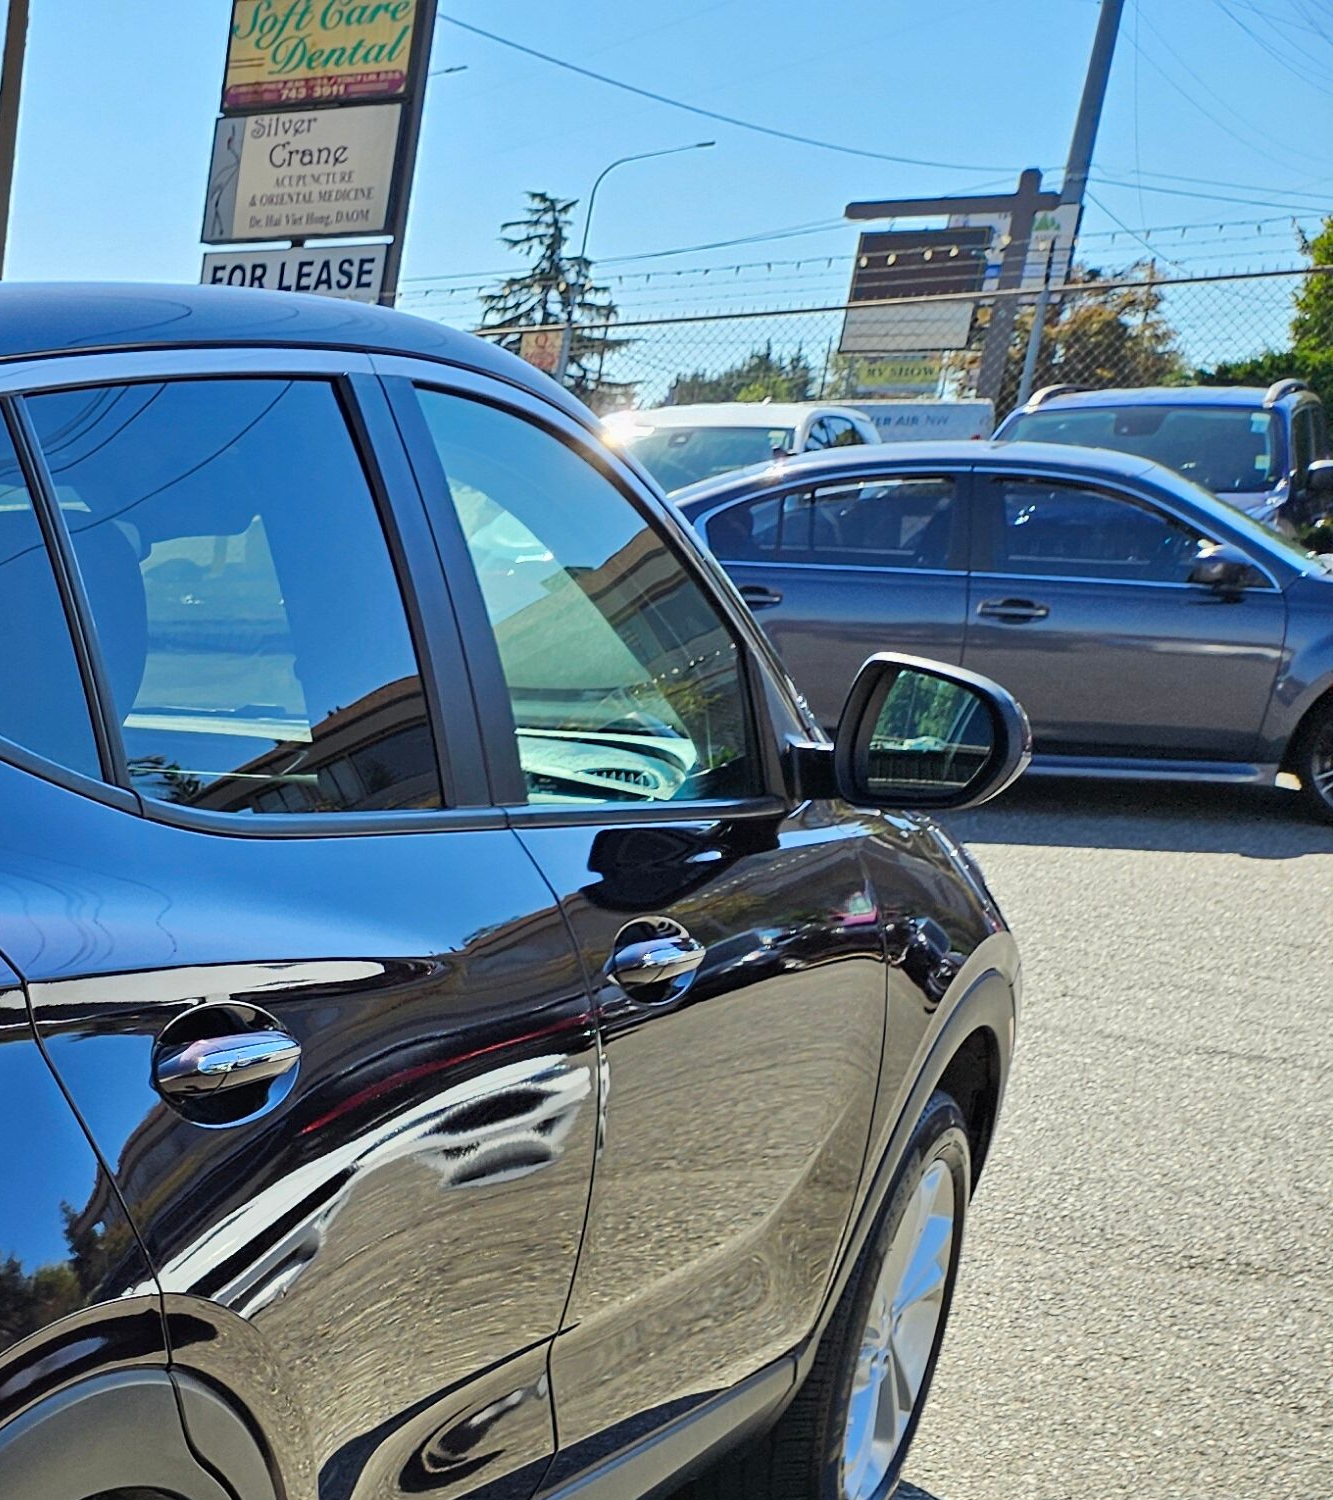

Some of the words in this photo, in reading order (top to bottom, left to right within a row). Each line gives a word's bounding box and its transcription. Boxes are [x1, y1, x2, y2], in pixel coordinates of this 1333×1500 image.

[232, 0, 315, 50] Soft
[320, 0, 414, 31] Care
[267, 23, 411, 75] Dental
[250, 116, 318, 139] Silver
[269, 142, 349, 168] Crane
[274, 170, 355, 188] ACUPUNCTURE
[249, 194, 257, 207] &
[259, 190, 313, 207] ORIENTAL
[318, 186, 374, 203] MEDICINE
[210, 262, 268, 289] FOR
[276, 256, 376, 292] LEASE
